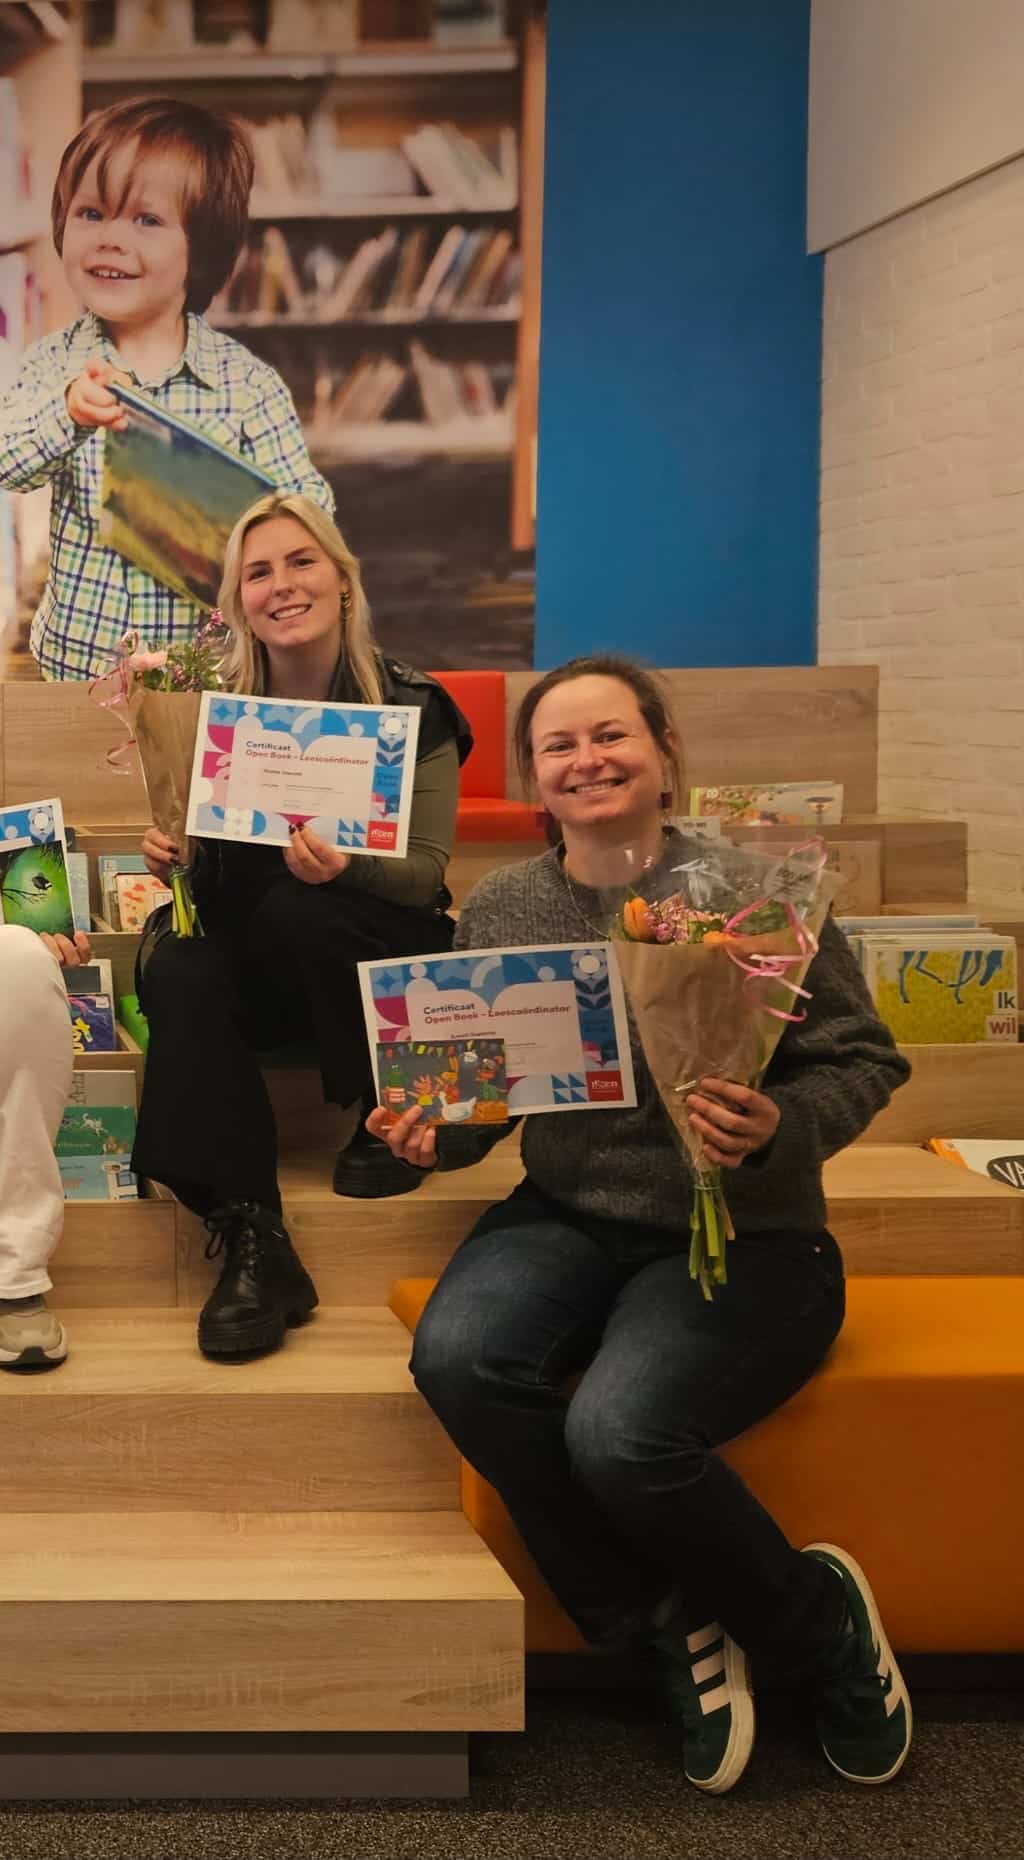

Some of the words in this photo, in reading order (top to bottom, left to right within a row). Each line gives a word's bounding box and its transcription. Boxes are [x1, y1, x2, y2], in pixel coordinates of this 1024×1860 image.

[246, 741, 291, 751] Certificaat
[246, 749, 269, 759] Open
[998, 991, 1015, 1009] Ik
[424, 1003, 475, 1014] Certificaat
[425, 1015, 452, 1025] Open
[454, 1012, 479, 1021] Boek
[989, 1017, 1016, 1034] wil
